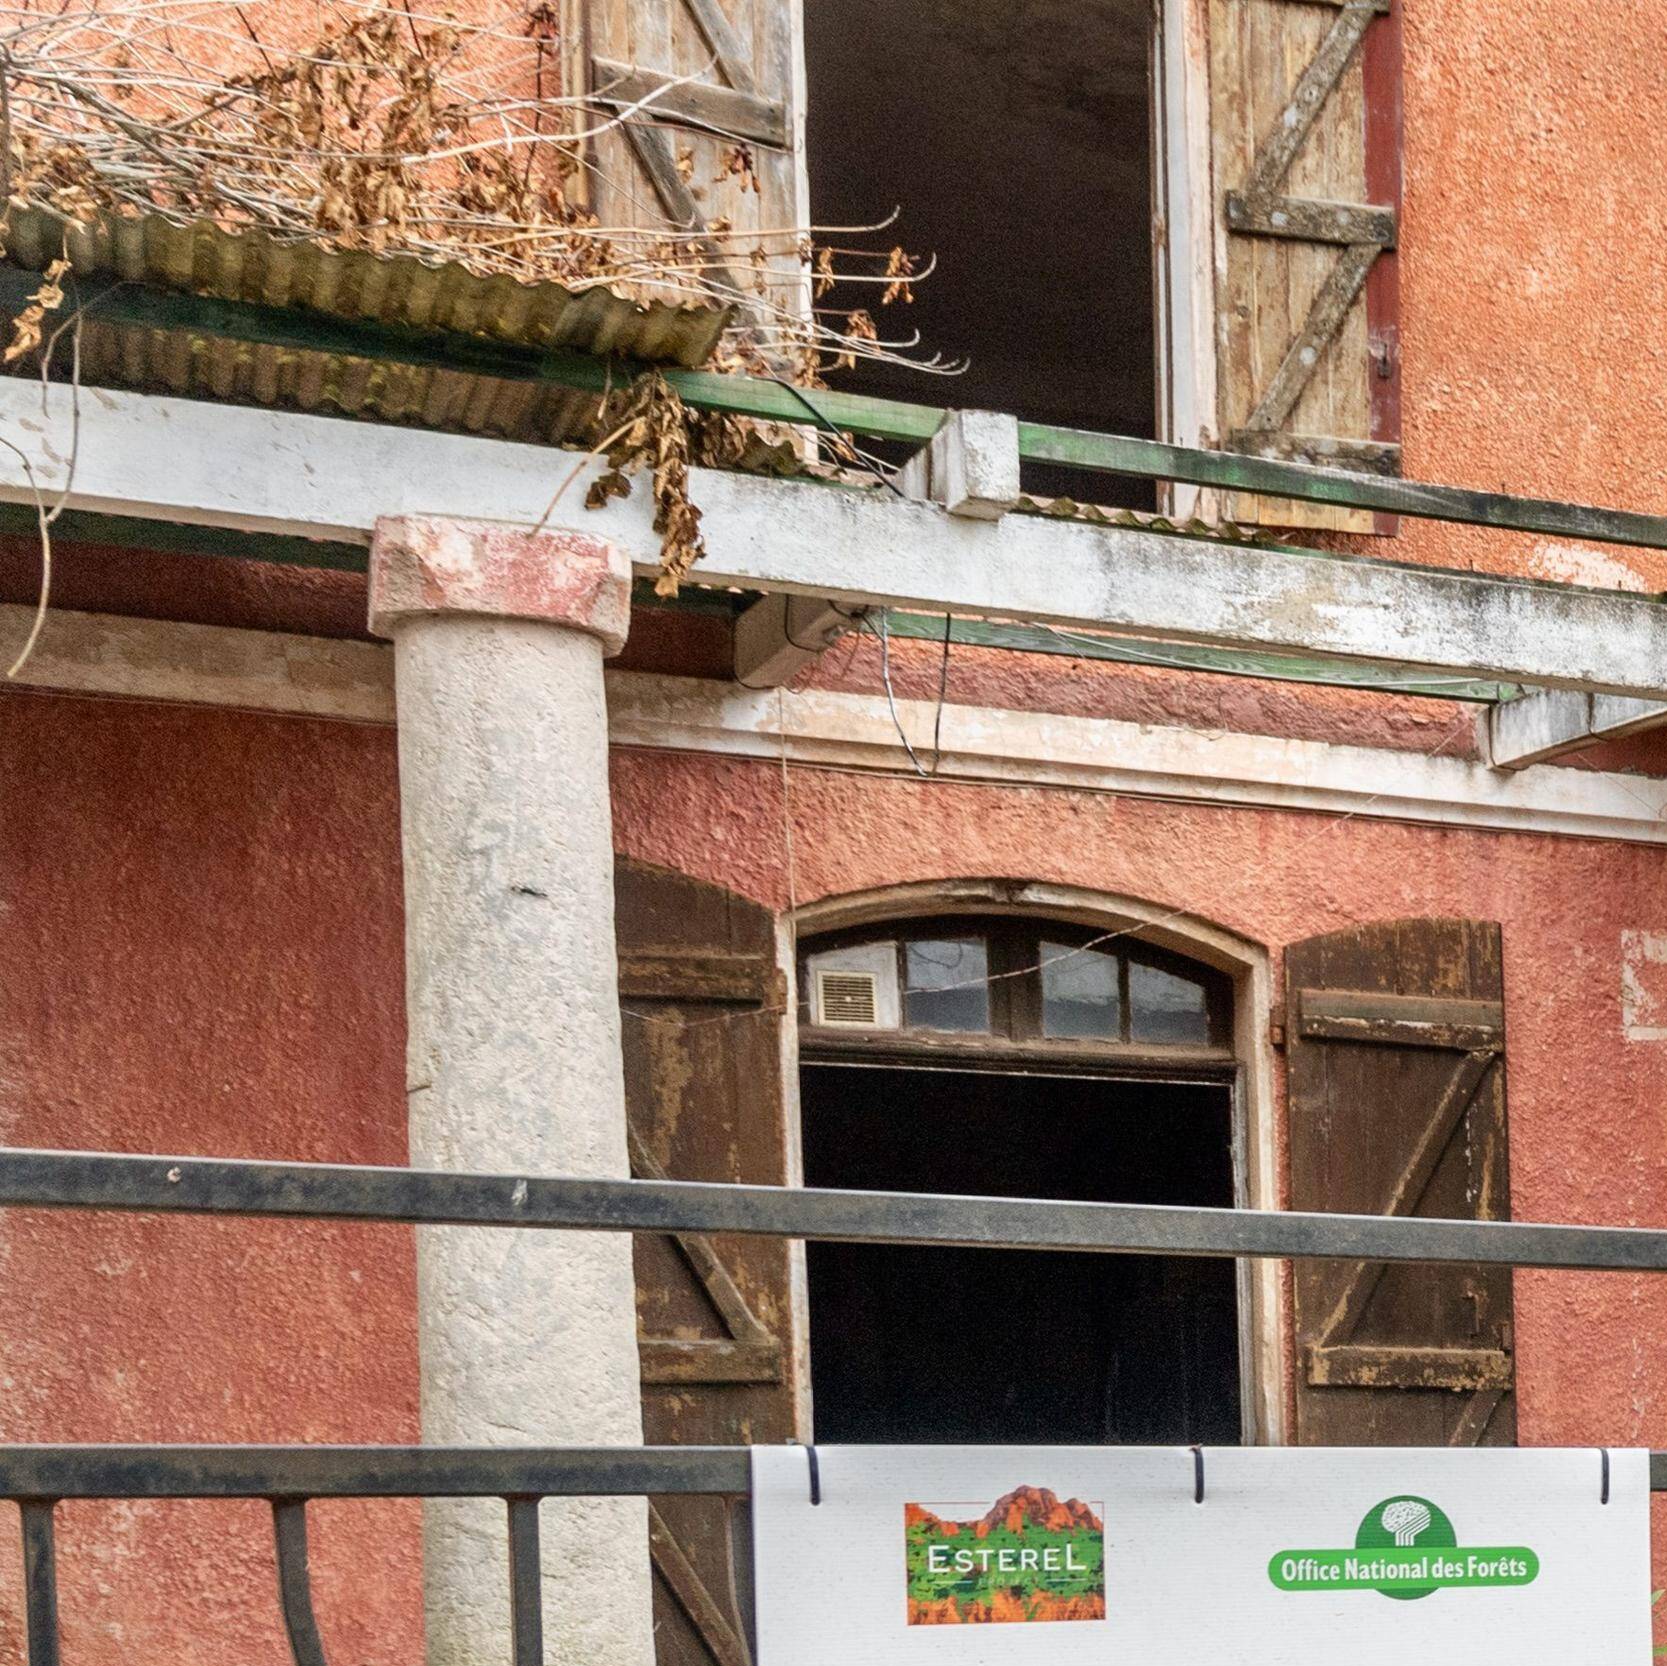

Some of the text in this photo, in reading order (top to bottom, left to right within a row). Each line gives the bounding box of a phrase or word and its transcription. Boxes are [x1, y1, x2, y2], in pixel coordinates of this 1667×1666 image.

[928, 1542, 1087, 1573] ESTEREL
[1280, 1554, 1528, 1582] Office National des Forêts
